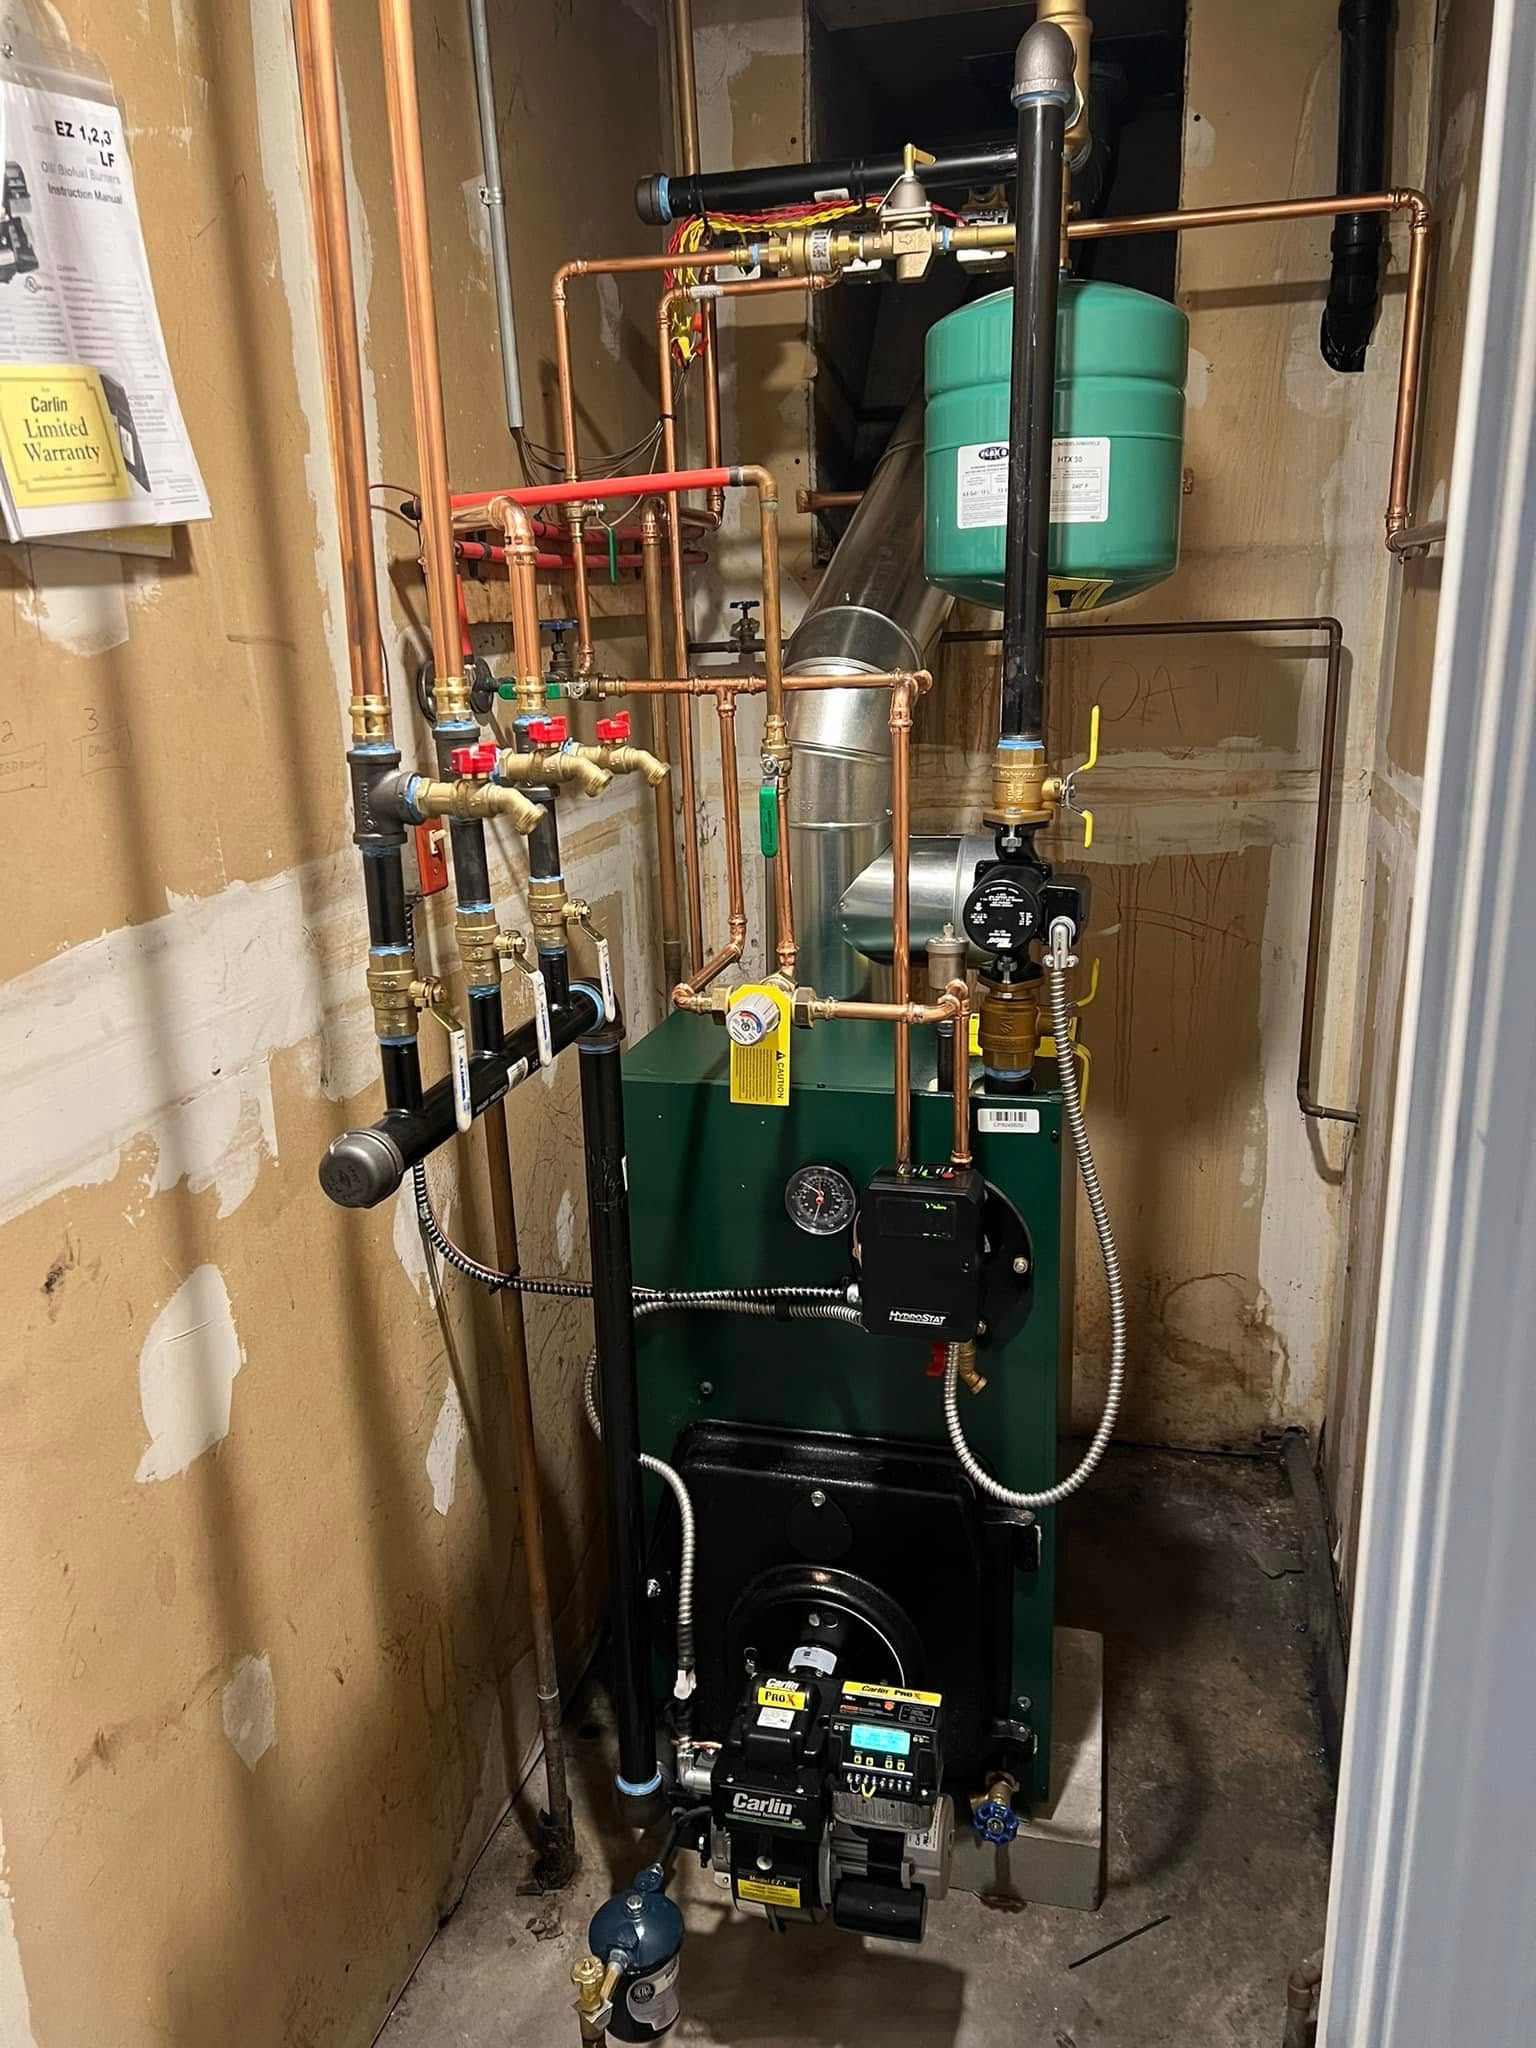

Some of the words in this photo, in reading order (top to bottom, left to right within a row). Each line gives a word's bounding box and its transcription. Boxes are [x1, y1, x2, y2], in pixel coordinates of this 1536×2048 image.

[54, 119, 75, 138] EZ
[79, 125, 112, 147] 1,2,3
[99, 150, 115, 167] LF
[47, 182, 93, 200] Instruction
[94, 189, 123, 204] Manual
[30, 396, 68, 413] Carlin
[24, 415, 89, 439] Limited
[23, 442, 100, 464] Warranty
[83, 707, 99, 732] 3
[1, 720, 17, 743] 2
[776, 1062, 785, 1099] CAUTION
[765, 1678, 800, 1691] Carlin
[861, 1685, 889, 1694] Carlin
[732, 1792, 793, 1816] Carlin
